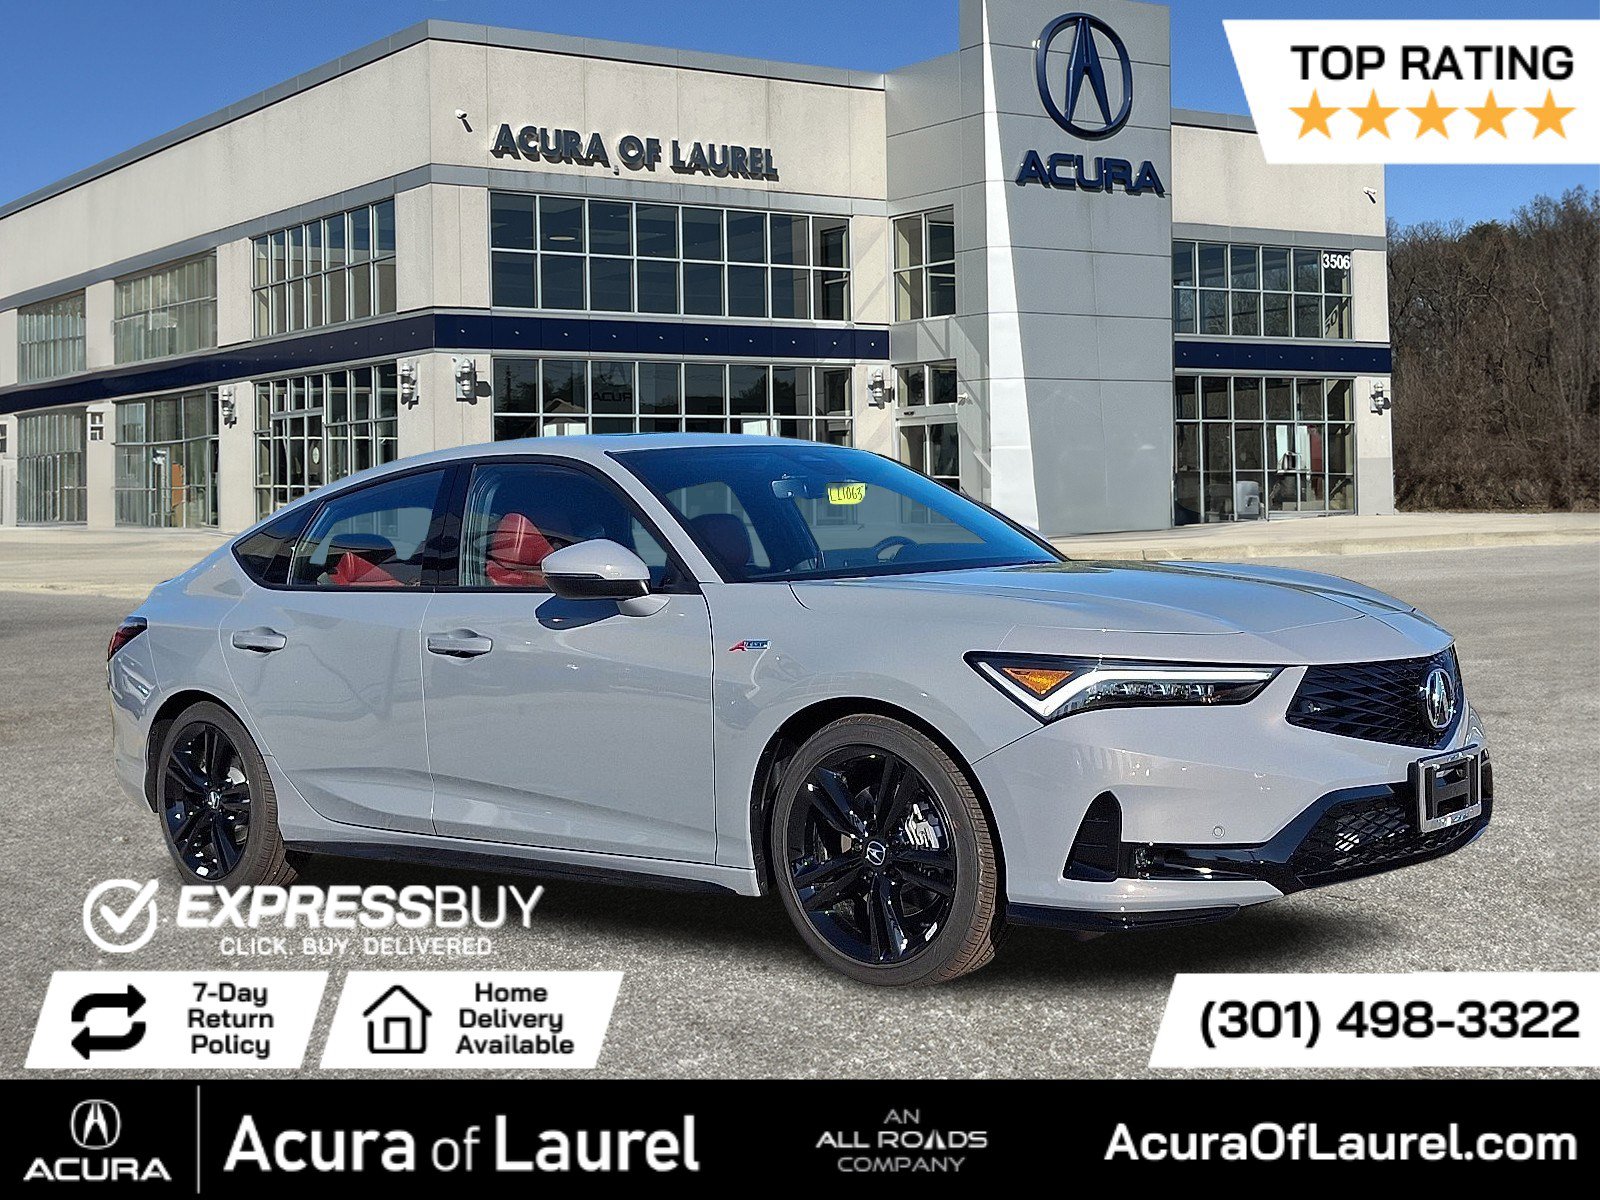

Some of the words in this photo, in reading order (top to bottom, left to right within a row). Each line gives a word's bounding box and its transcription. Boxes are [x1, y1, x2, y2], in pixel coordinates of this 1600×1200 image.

[490, 123, 611, 167] ACURA
[616, 135, 662, 171] OF
[670, 140, 780, 181] LAUREL
[1015, 150, 1166, 198] ACURA
[1322, 253, 1351, 270] 3506
